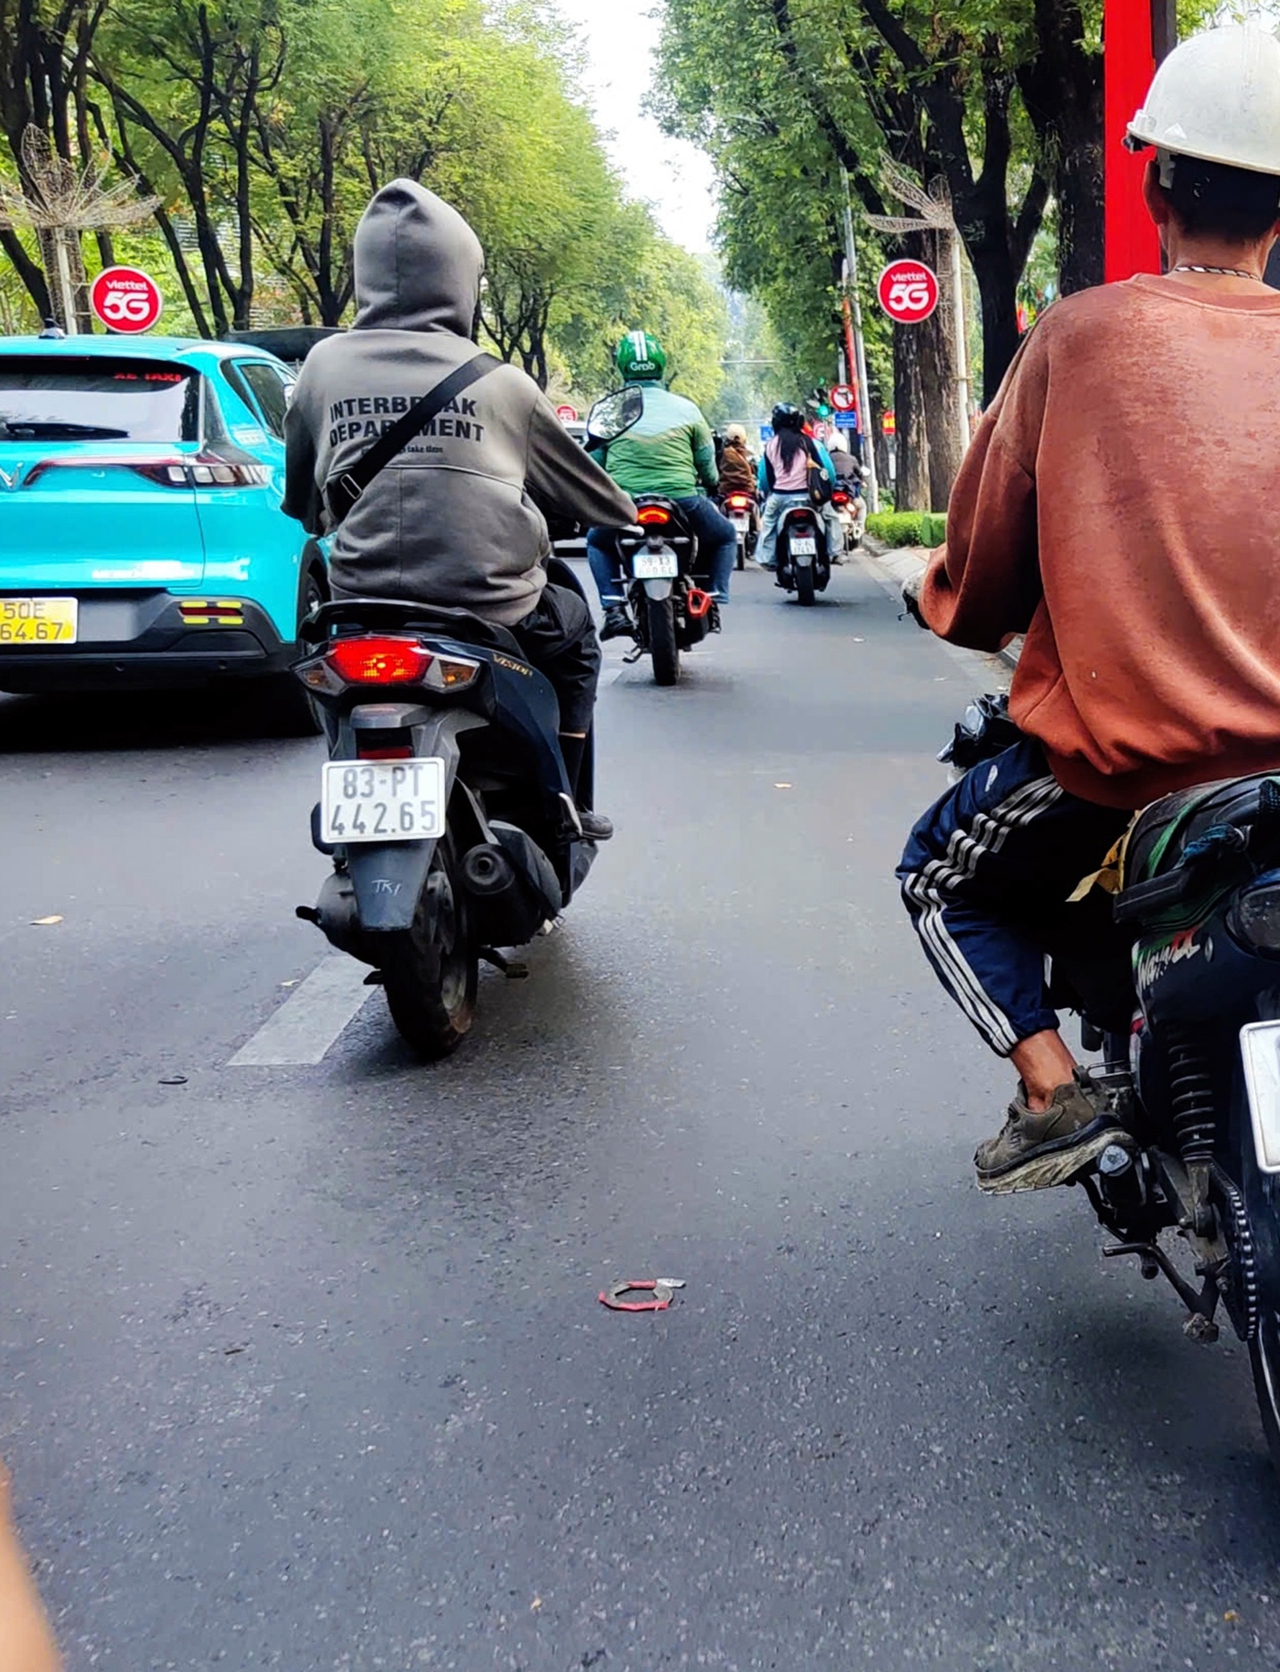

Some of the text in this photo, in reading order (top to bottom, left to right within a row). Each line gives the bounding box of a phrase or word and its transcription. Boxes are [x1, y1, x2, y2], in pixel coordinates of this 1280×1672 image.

[105, 280, 149, 291] viettel
[890, 272, 928, 282] viettel
[103, 291, 150, 321] 5G
[888, 283, 930, 311] 5G
[630, 361, 656, 371] Grab
[330, 396, 477, 424] INTERBRAK
[3, 602, 46, 620] 50E
[0, 622, 63, 641] 64.67
[331, 800, 436, 835] 442.65
